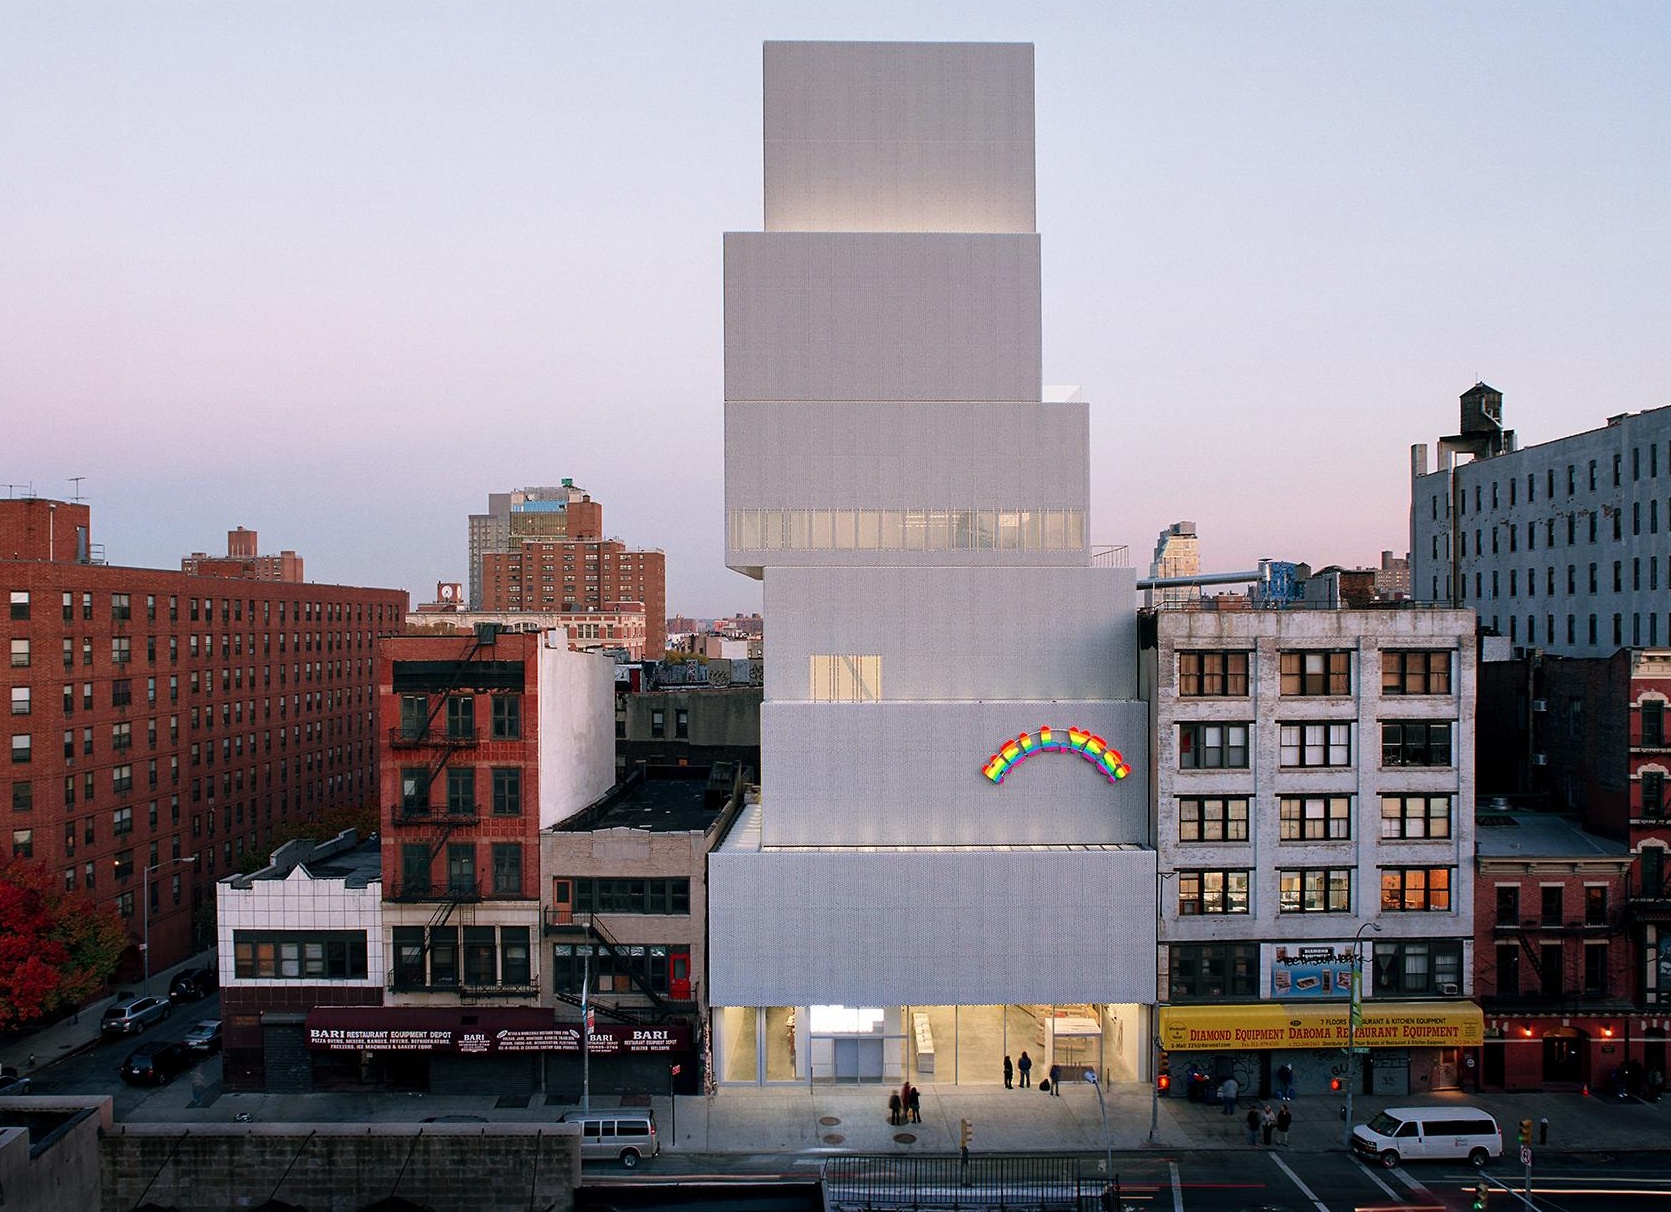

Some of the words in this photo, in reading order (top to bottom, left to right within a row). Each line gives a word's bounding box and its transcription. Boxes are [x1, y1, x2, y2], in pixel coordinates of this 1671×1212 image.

[310, 1030, 345, 1038] BARI
[633, 1031, 668, 1039] BARI
[1190, 1029, 1232, 1041] DIAMOND
[1235, 1028, 1285, 1041] EQUIPMENT
[1289, 1027, 1331, 1039] DAROMA
[1336, 1026, 1398, 1038] RETAURANT
[1403, 1026, 1459, 1039] EQUIPMENT
[590, 1034, 613, 1042] BARI
